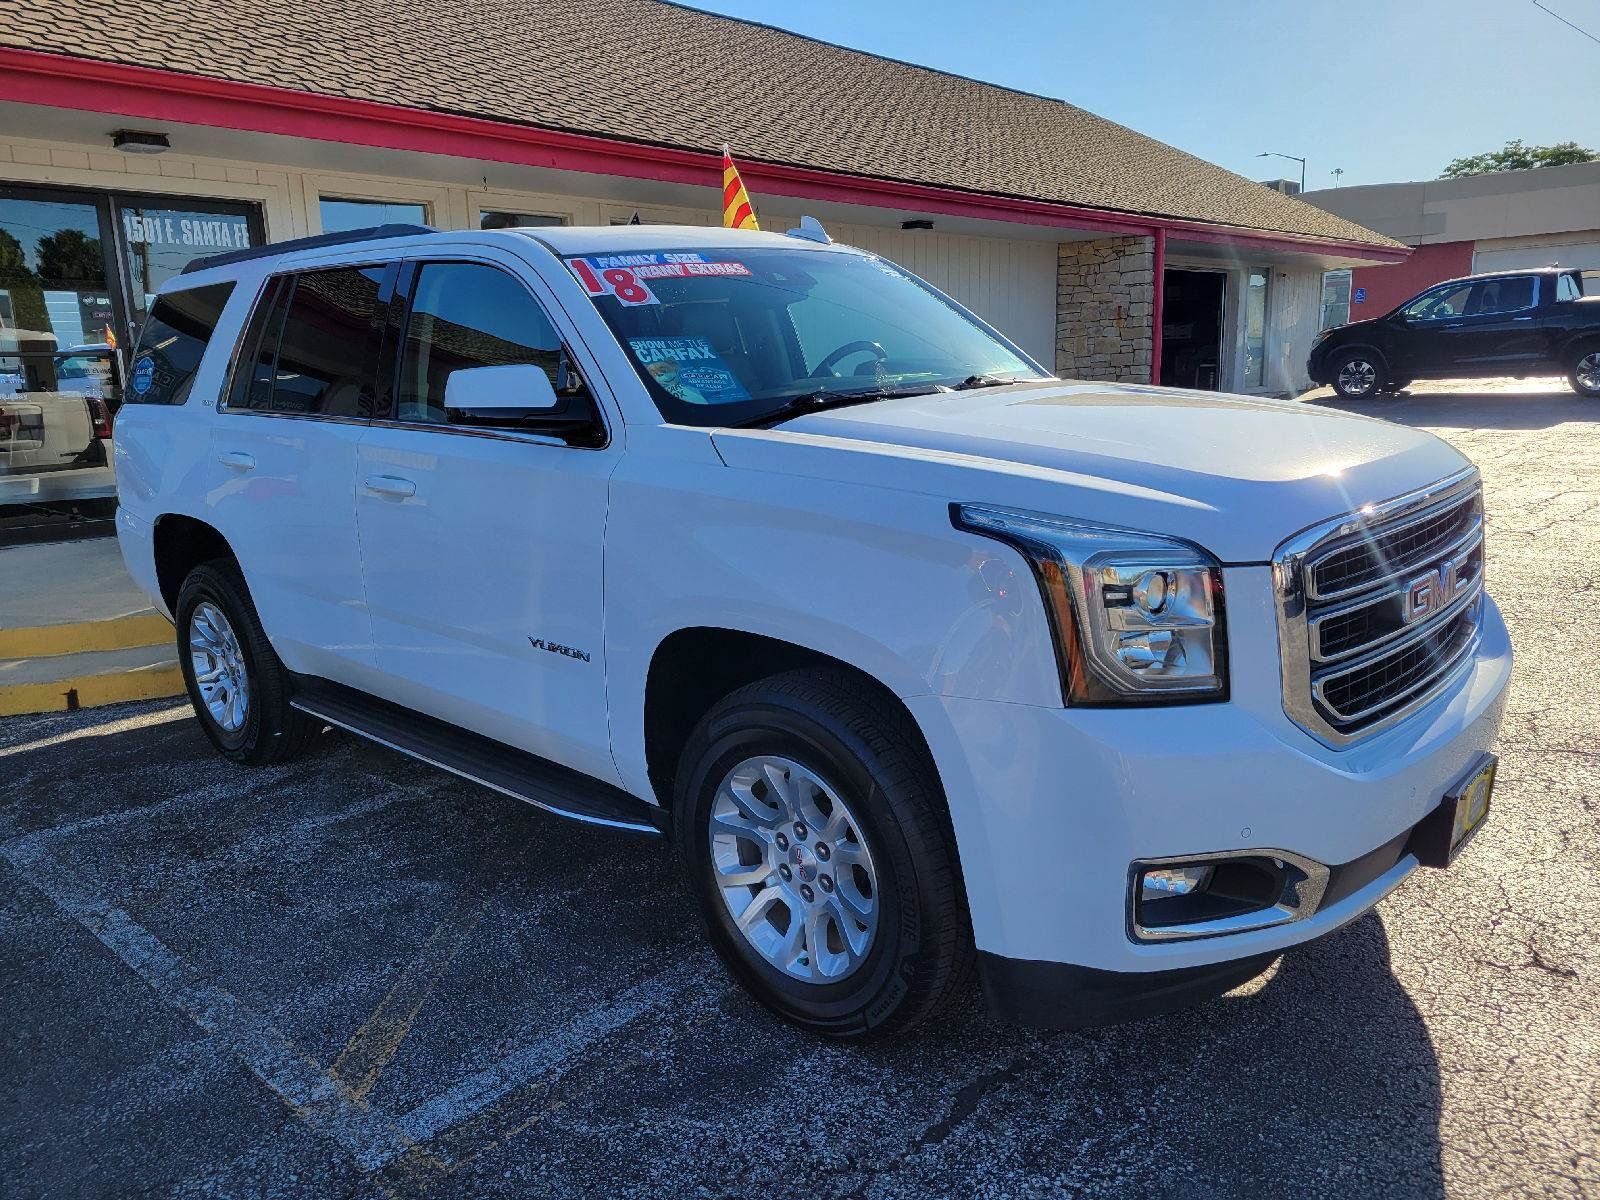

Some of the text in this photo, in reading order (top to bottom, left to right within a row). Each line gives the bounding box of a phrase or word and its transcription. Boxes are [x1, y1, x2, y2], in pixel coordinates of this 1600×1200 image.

[122, 216, 250, 249] 1501 E. SANTA FE
[596, 253, 705, 268] FAMILY SIZE
[633, 263, 749, 278] MANY EXTRAS
[571, 259, 648, 303] 18
[629, 340, 667, 350] SHOW
[635, 346, 717, 363] CARFAX
[1402, 557, 1468, 624] GMC
[527, 636, 591, 662] YUKON
[796, 848, 807, 880] GMC
